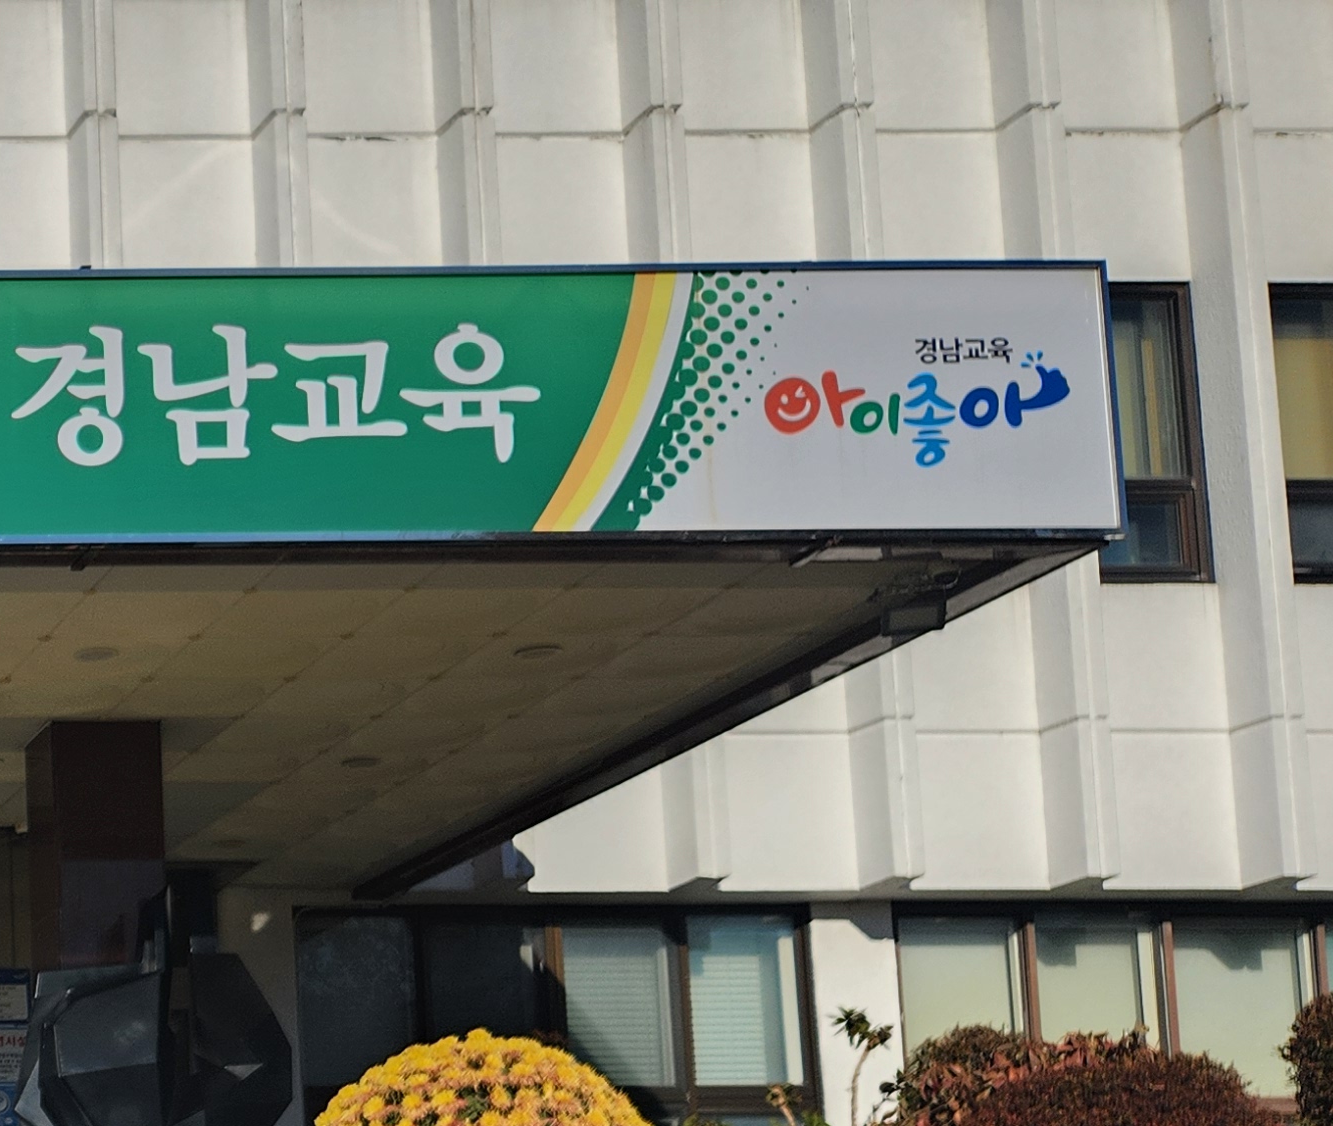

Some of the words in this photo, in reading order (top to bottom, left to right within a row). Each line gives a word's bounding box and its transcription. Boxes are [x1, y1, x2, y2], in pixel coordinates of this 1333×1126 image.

[14, 323, 540, 465] 경남교육
[915, 337, 1013, 364] 경남교육
[764, 365, 1071, 467] 아이좋아
